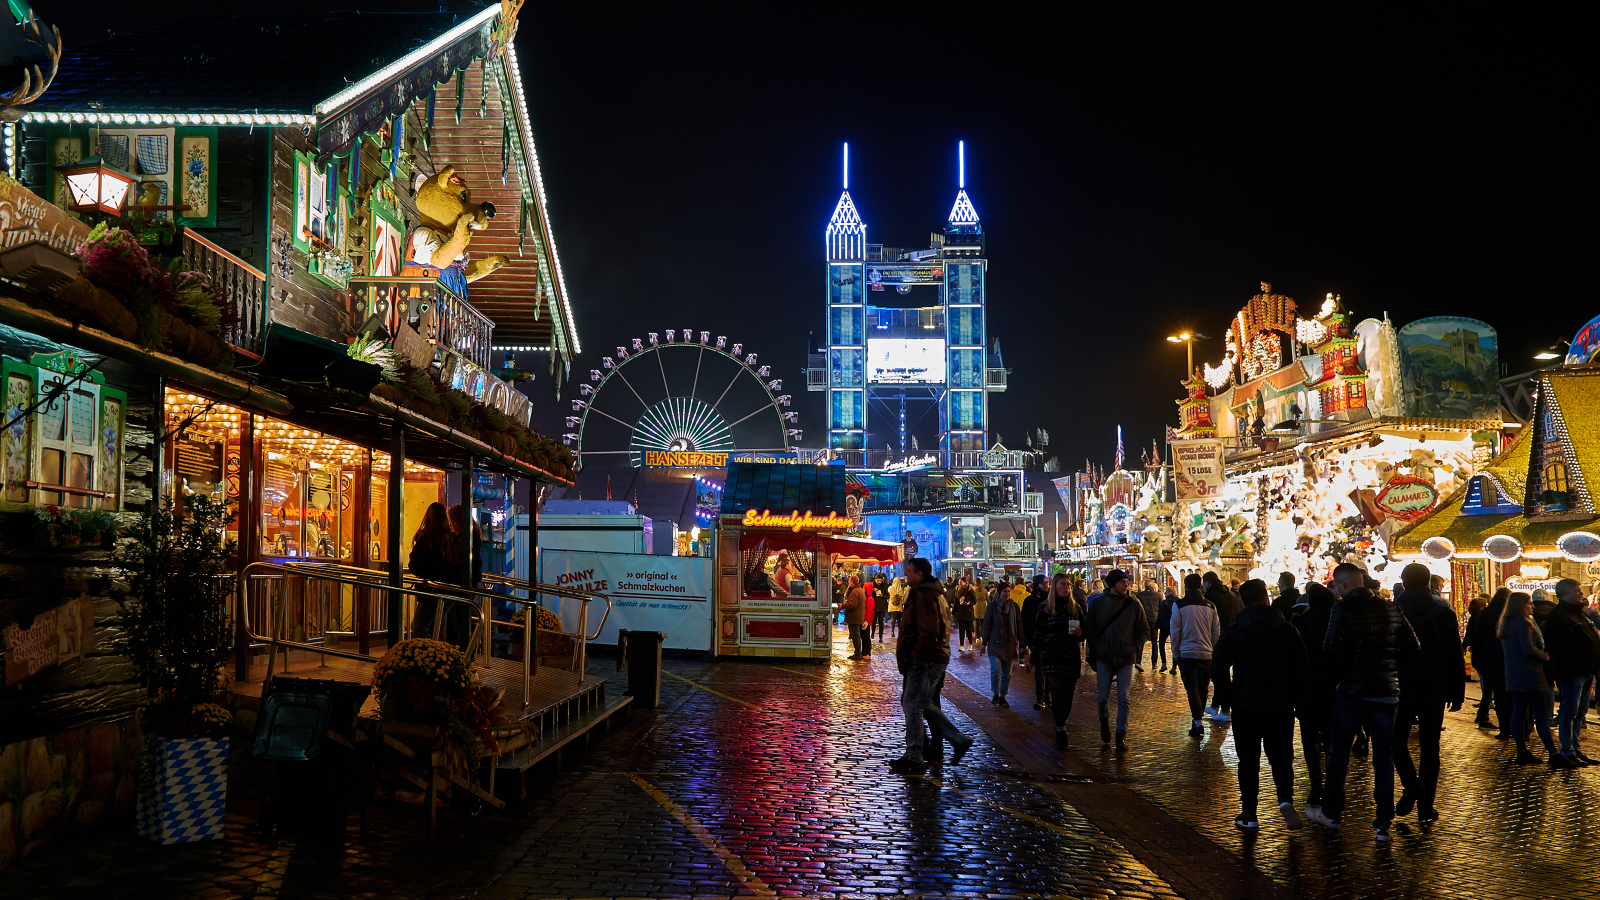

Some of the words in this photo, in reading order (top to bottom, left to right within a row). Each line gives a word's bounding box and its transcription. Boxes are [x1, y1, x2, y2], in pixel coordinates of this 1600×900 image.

[645, 451, 729, 466] HANSEZELT
[1388, 491, 1430, 504] CALAMARES
[742, 508, 854, 533] Schmalzkuchen
[555, 568, 595, 586] JONNY
[635, 571, 668, 582] original
[617, 581, 686, 593] Schmalzkuchen
[9, 612, 56, 647] Vorsicht!
